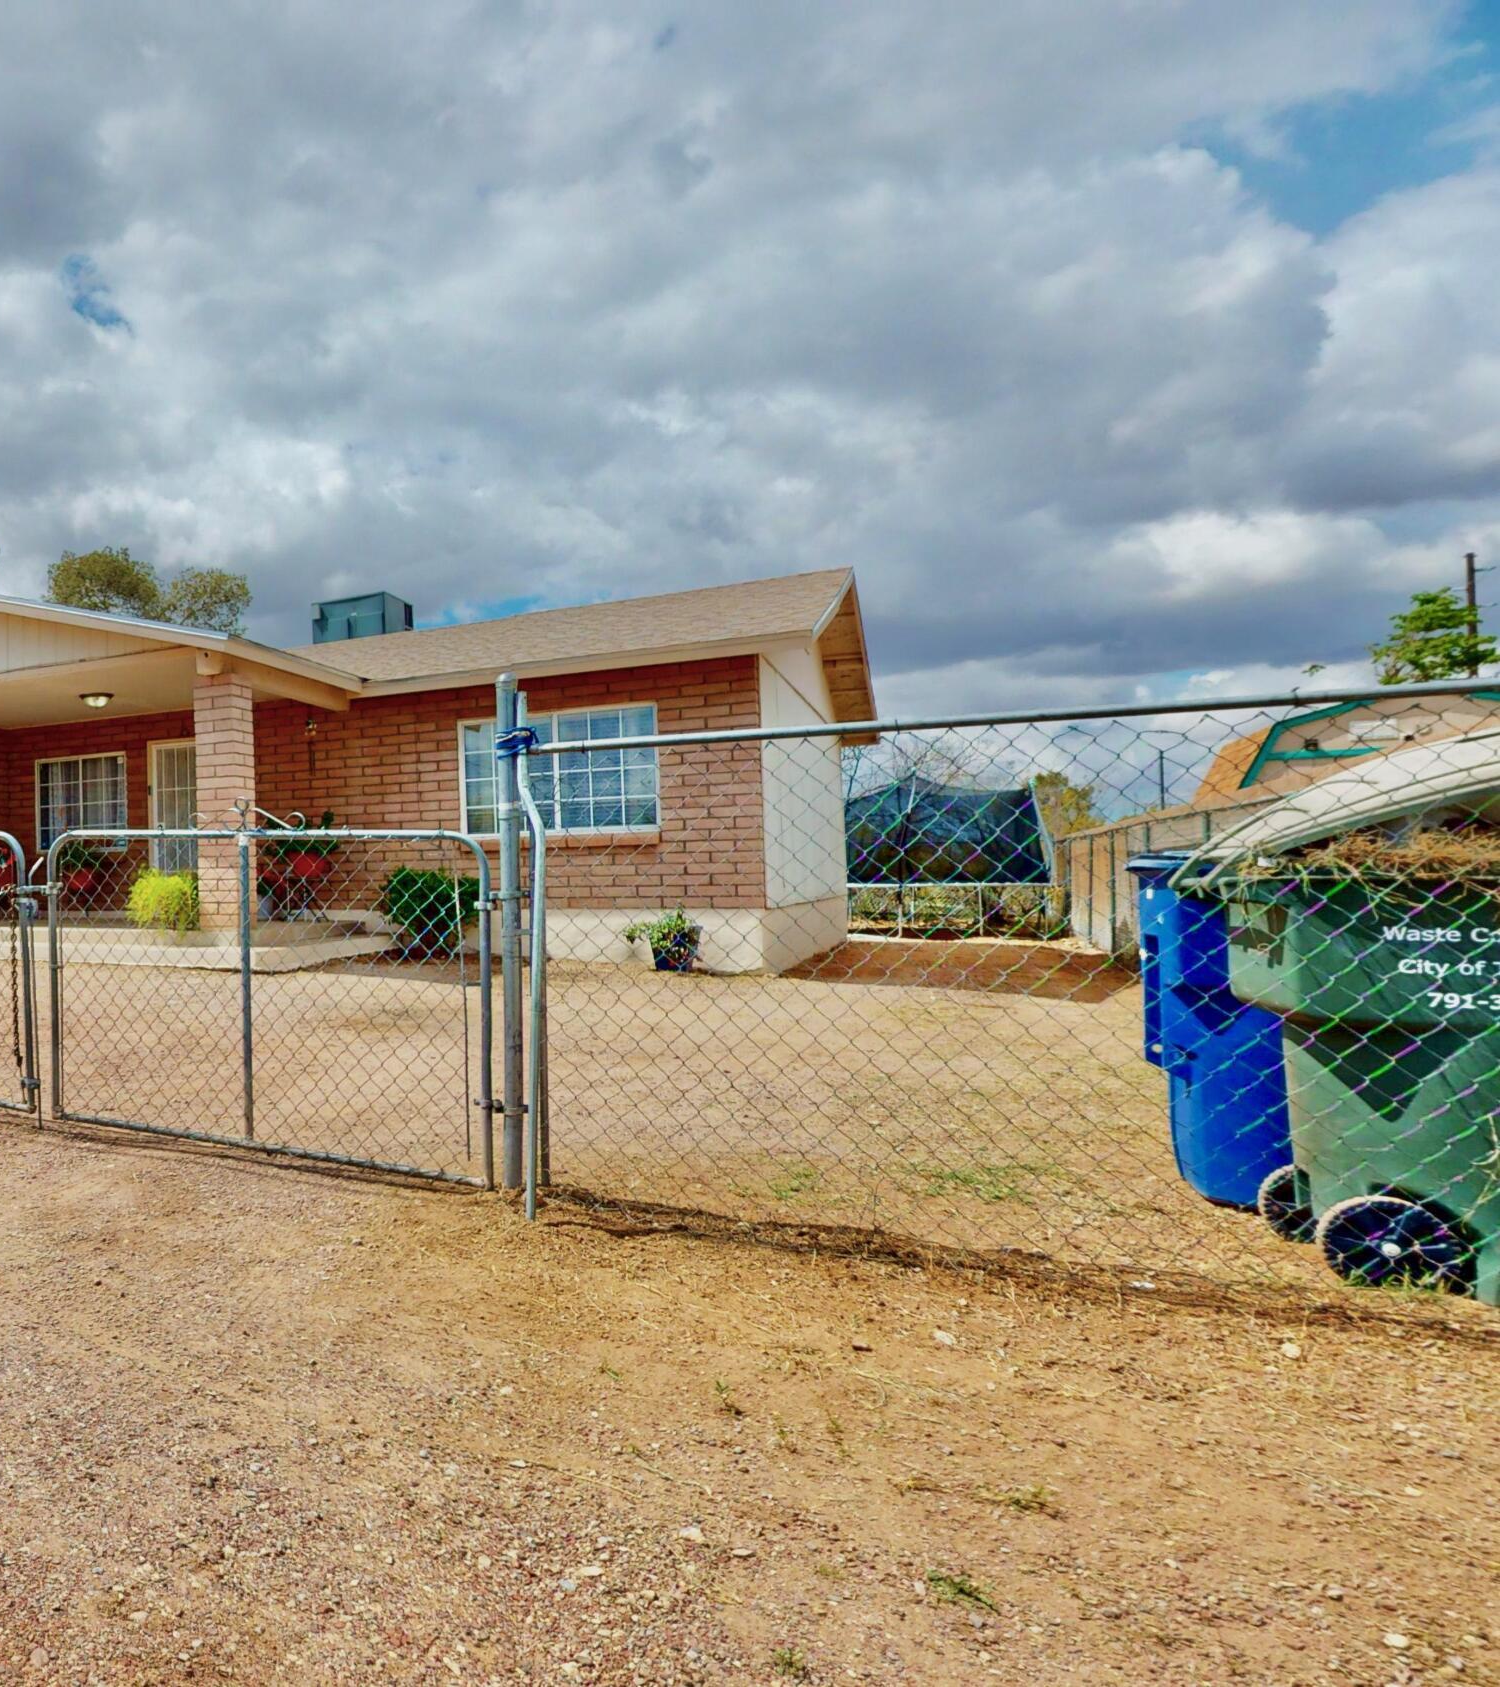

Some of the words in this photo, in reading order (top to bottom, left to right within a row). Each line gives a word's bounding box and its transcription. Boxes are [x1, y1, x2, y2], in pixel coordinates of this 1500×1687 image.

[1383, 926, 1461, 942] Waste
[1398, 959, 1449, 979] City
[1460, 961, 1486, 976] of
